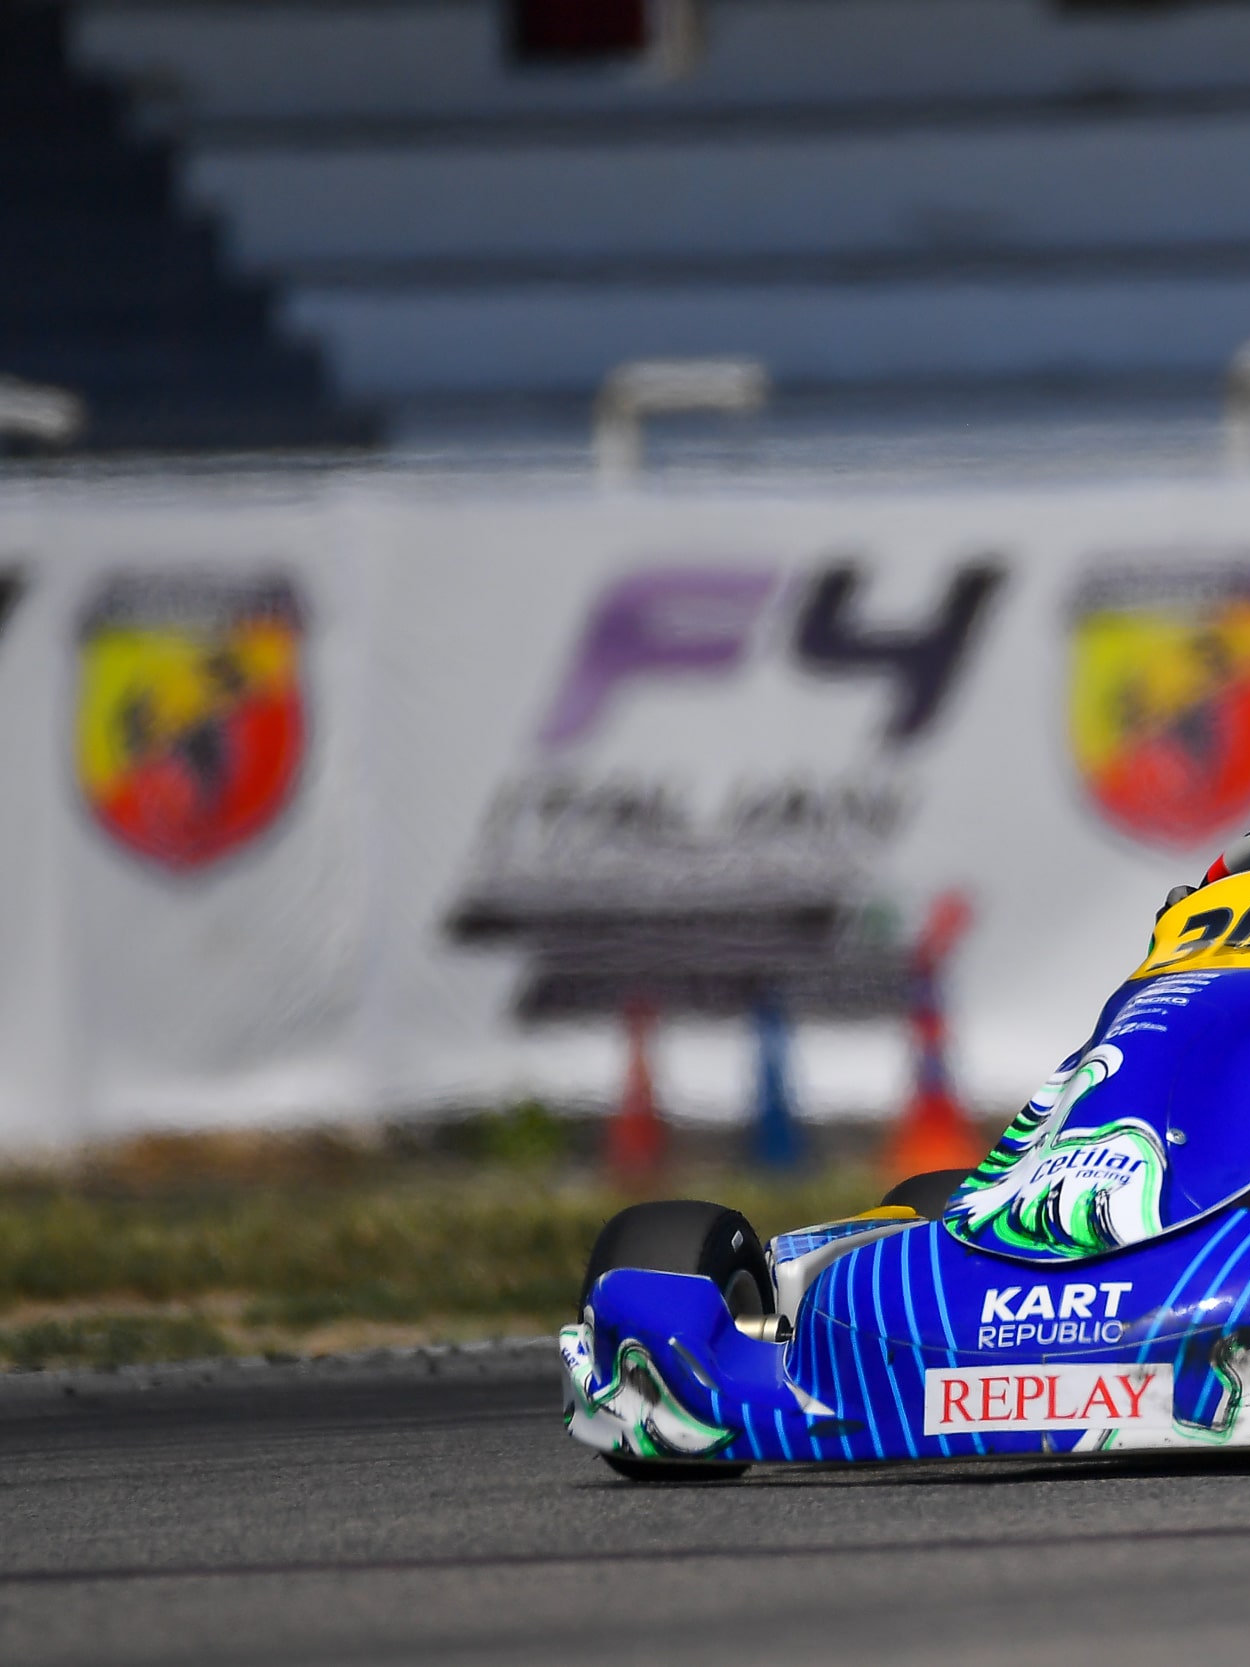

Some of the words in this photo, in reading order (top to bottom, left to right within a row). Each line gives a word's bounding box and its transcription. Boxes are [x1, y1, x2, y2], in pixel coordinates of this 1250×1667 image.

[540, 560, 1008, 748] F4
[1030, 1147, 1149, 1184] Cetilar
[1075, 1168, 1132, 1186] racing
[981, 1282, 1133, 1323] KART
[977, 1319, 1126, 1350] REPUBLIC
[939, 1373, 1157, 1424] REPLAY
